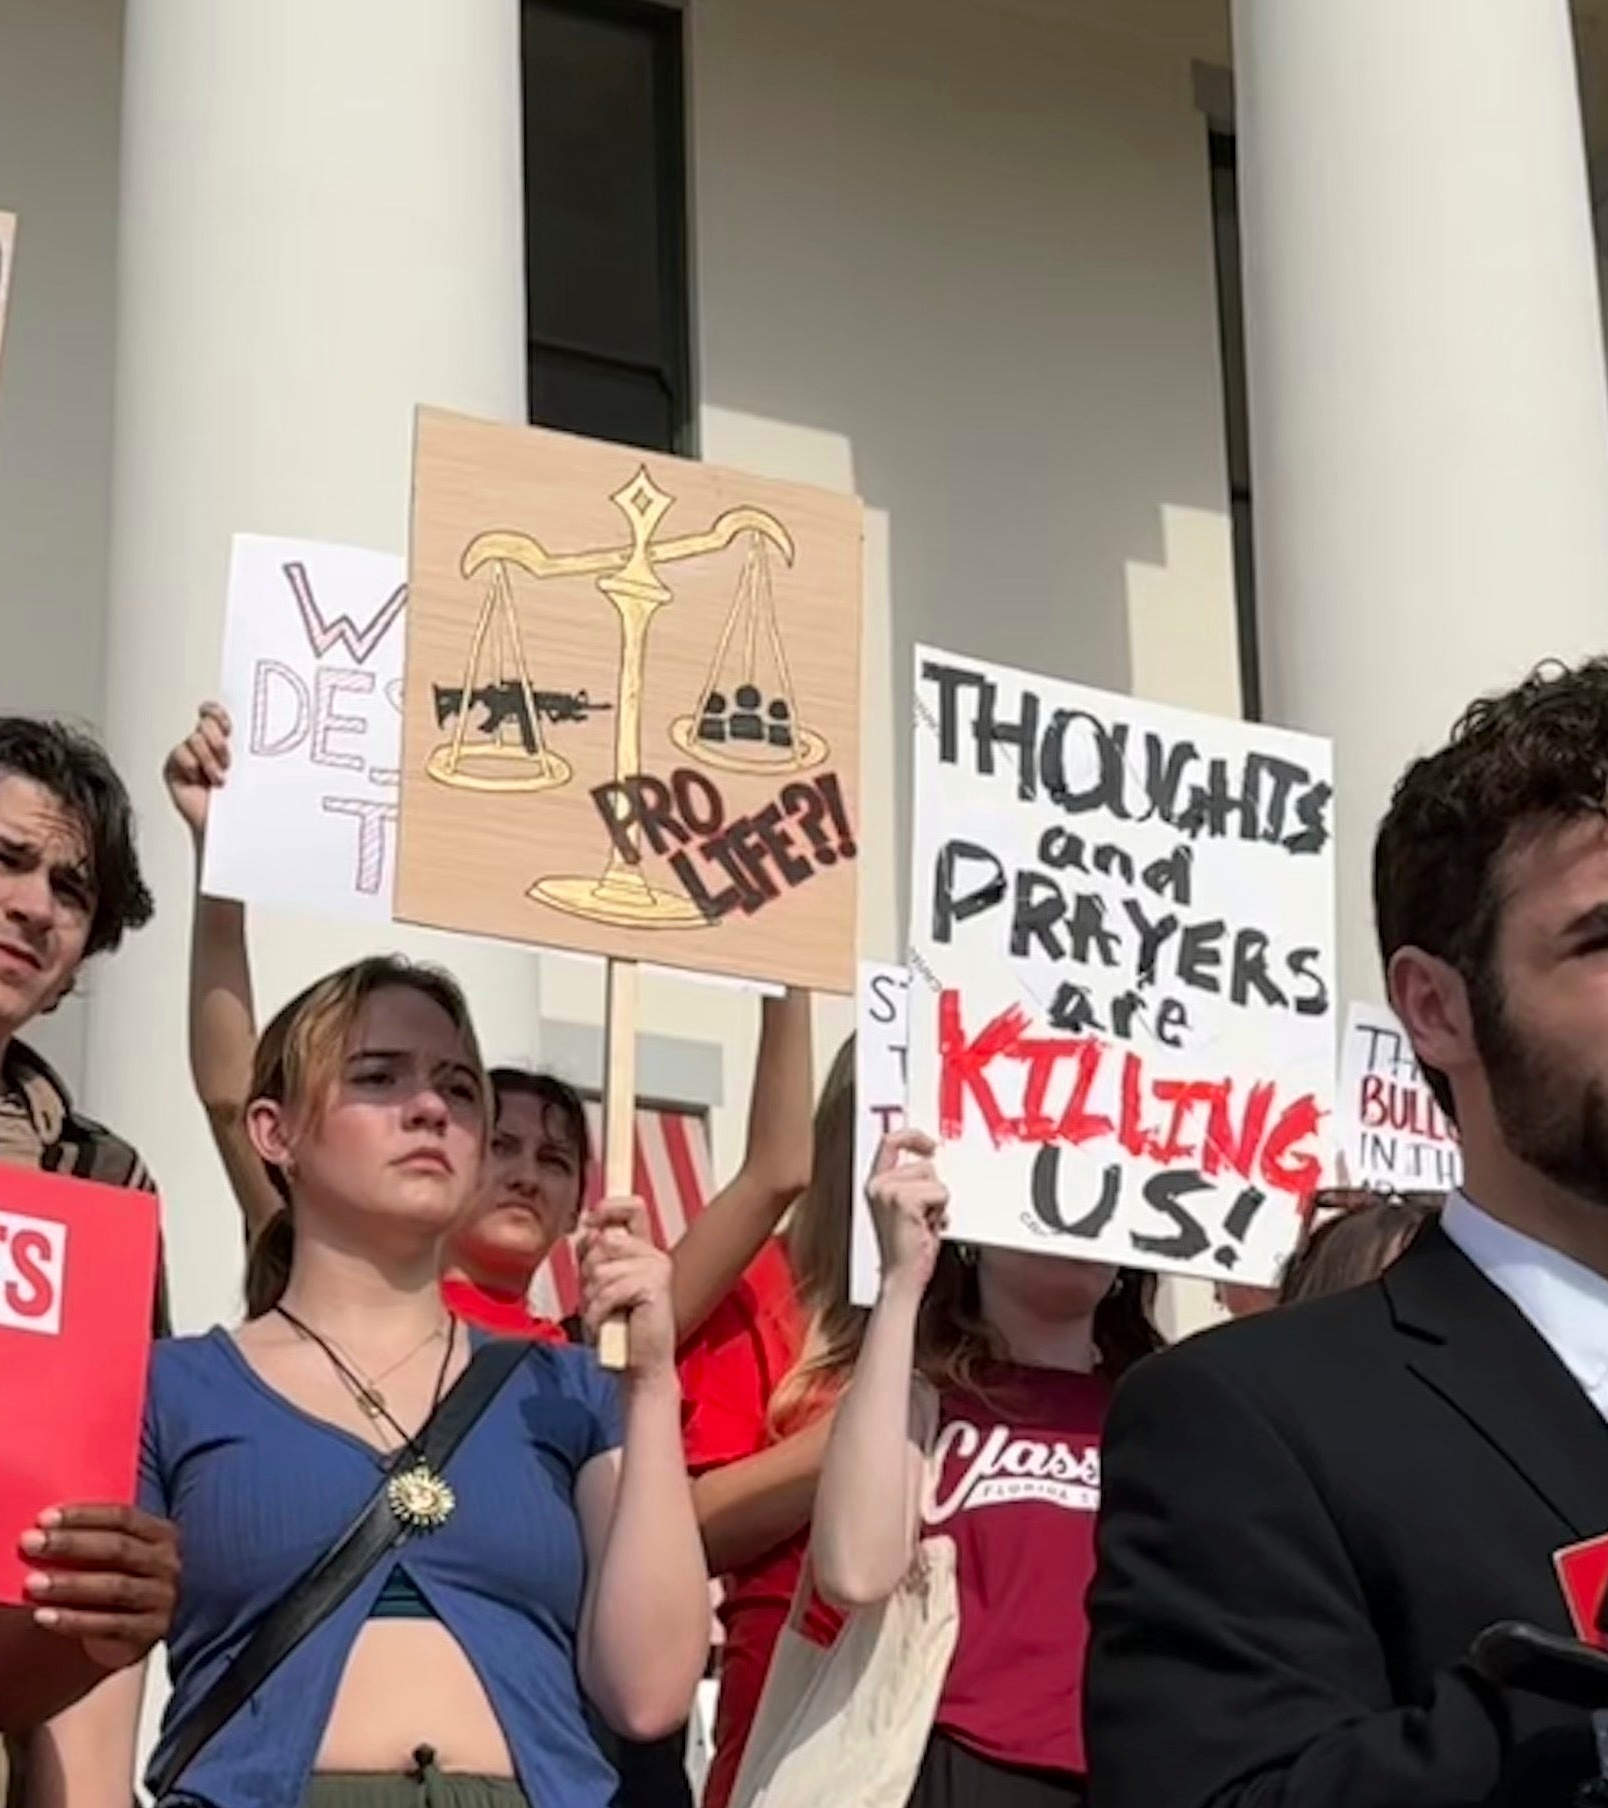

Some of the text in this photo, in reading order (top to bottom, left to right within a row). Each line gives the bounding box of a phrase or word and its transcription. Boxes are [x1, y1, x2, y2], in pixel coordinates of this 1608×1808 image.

[590, 768, 725, 866] PRO
[922, 661, 1333, 854] THOUGHTS
[668, 771, 858, 920] LIFE?!
[1038, 823, 1195, 906] and
[932, 839, 1329, 1016] PRAYERS
[1048, 981, 1192, 1048] are
[938, 988, 1334, 1214] KILLING
[1360, 1132, 1397, 1170] IN
[1031, 1146, 1266, 1271] US!
